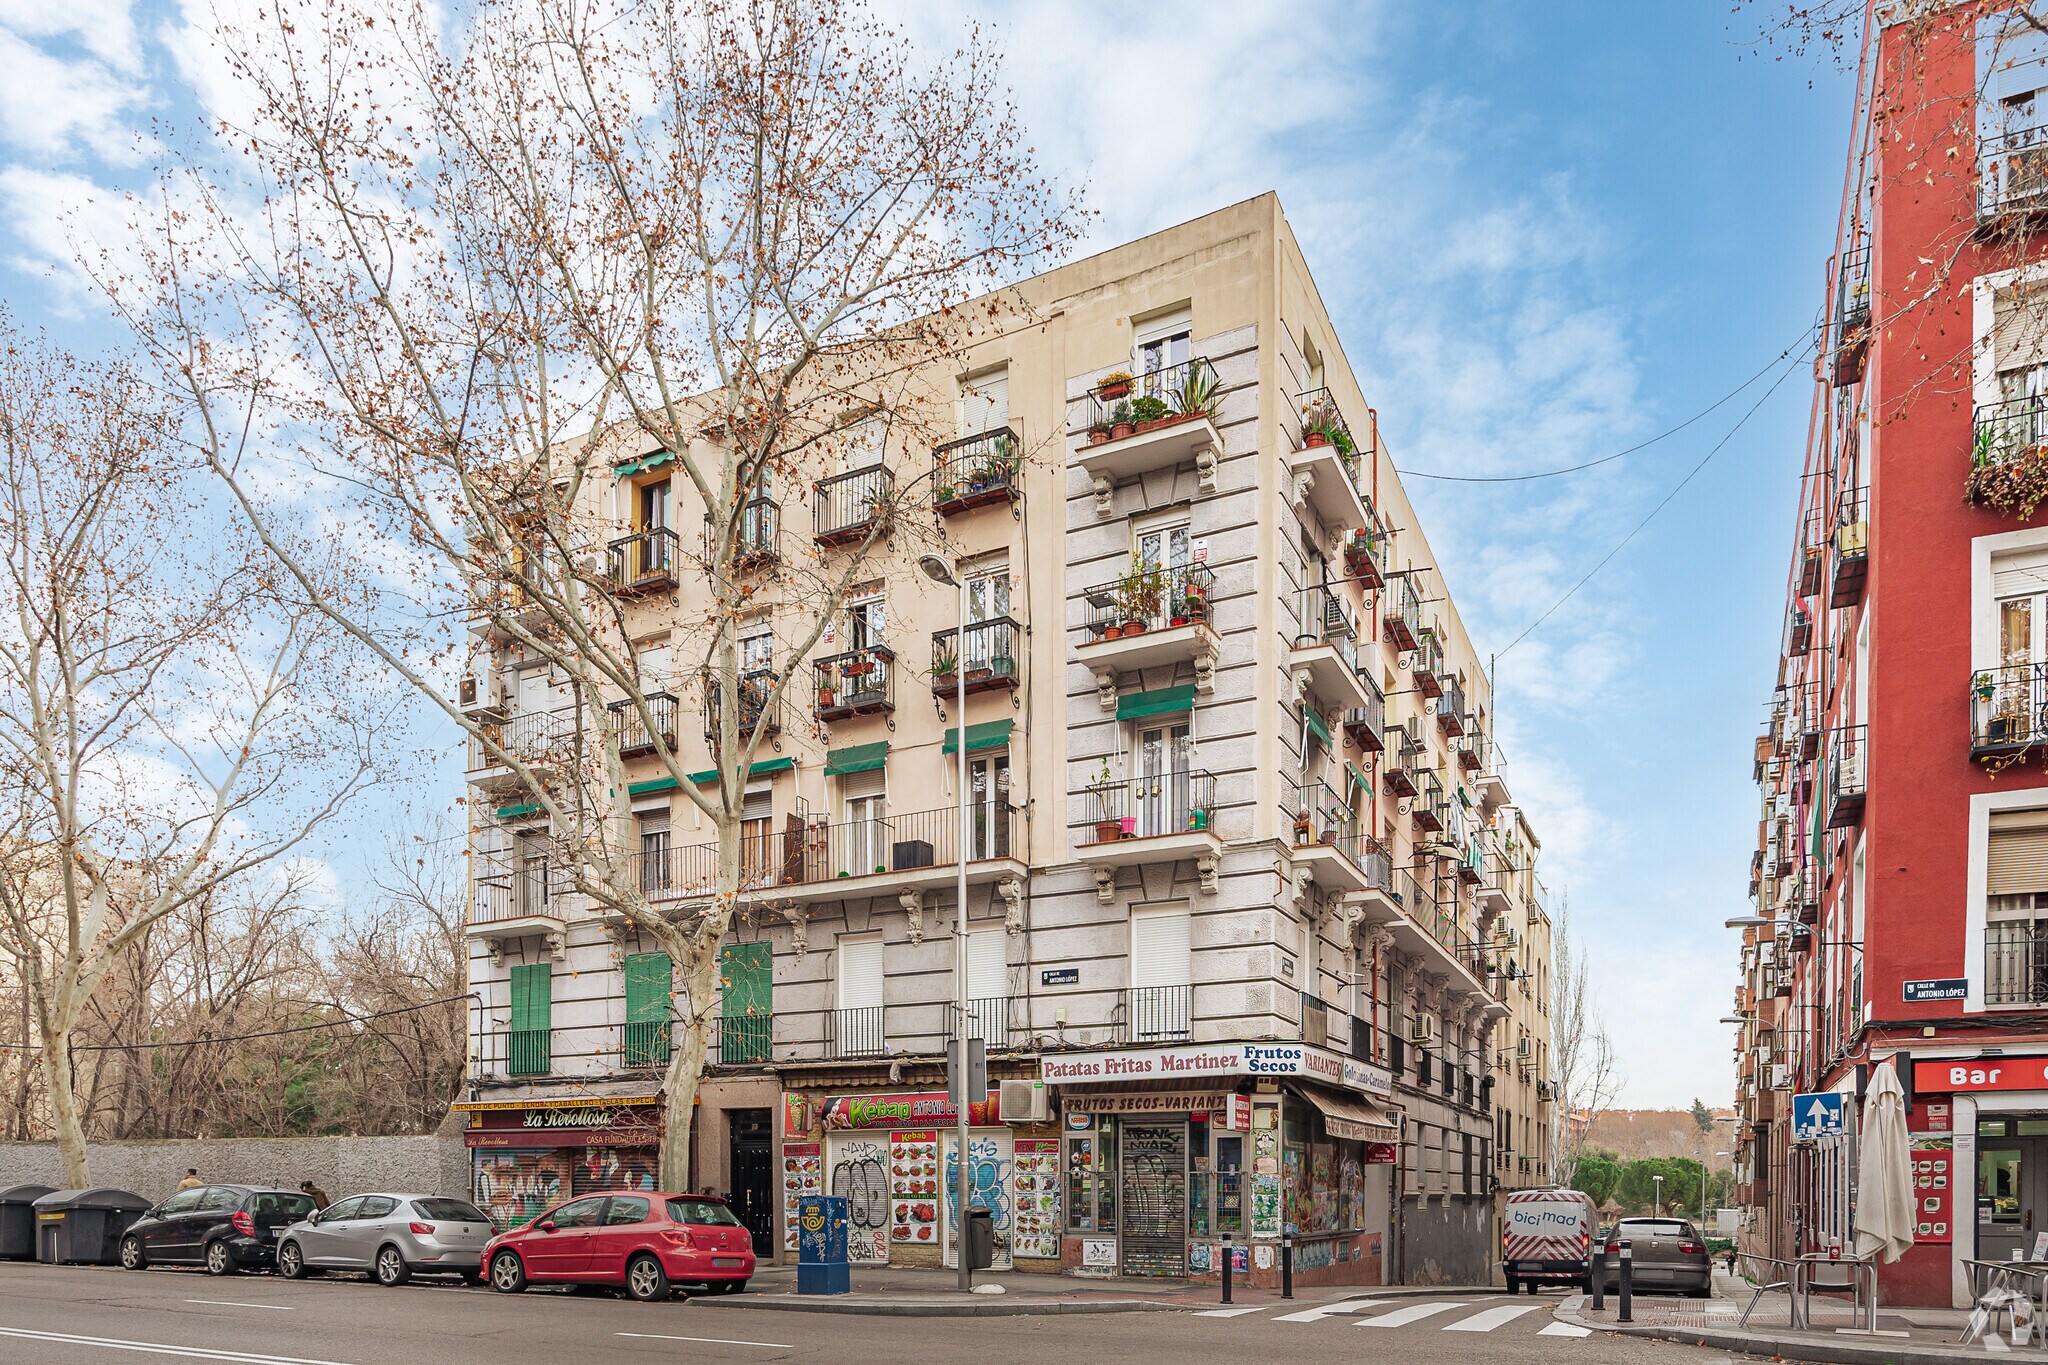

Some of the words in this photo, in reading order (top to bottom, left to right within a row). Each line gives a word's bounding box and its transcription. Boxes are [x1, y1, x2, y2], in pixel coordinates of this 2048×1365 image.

[1917, 990, 1945, 999] ANTONIO
[1946, 986, 1965, 998] LÓPEZ
[1244, 1046, 1302, 1060] Frutos
[1044, 1061, 1100, 1079] Patatas
[1104, 1057, 1152, 1075] Fritas
[1160, 1053, 1239, 1072] Martinez
[1249, 1059, 1297, 1072] Secos
[1304, 1052, 1342, 1078] VARIANTES
[1949, 1066, 2002, 1086] Bar
[554, 1099, 594, 1107] CABALLERO
[1067, 1098, 1115, 1112] FRUTOS
[1119, 1096, 1227, 1111] SECOS-VARIANT
[523, 1110, 543, 1127] La
[544, 1107, 612, 1127] Revoltosa
[850, 1098, 911, 1129] Kebap
[913, 1100, 944, 1116] ANTONIO
[478, 1136, 509, 1146] Revoltosa
[586, 1135, 603, 1144] CASA
[604, 1135, 636, 1144] FUNDADA
[901, 1132, 927, 1142] Kebab
[1514, 1210, 1541, 1226] bici
[1542, 1211, 1577, 1226] mad
